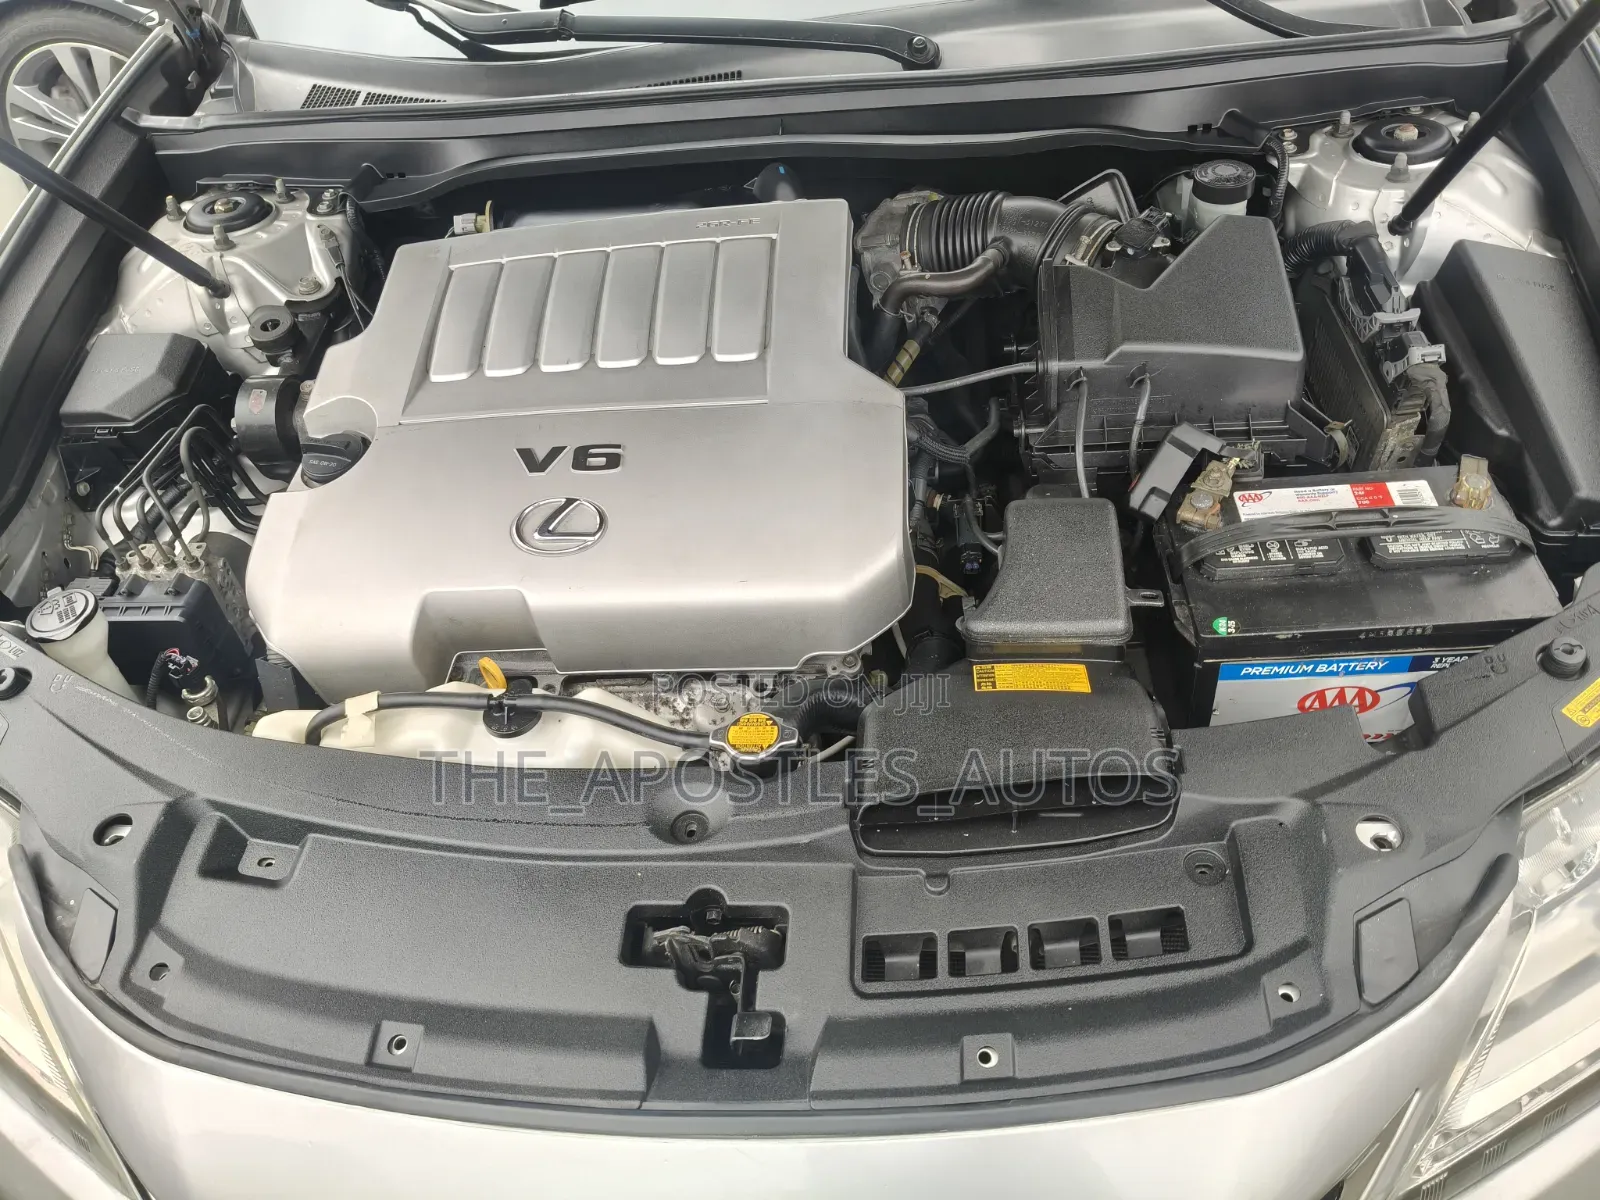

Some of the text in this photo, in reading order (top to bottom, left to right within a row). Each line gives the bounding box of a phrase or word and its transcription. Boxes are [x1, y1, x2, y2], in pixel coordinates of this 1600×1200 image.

[513, 443, 623, 476] V6
[1239, 492, 1264, 503] AAA
[1240, 661, 1390, 676] PREMIUM BATTERY
